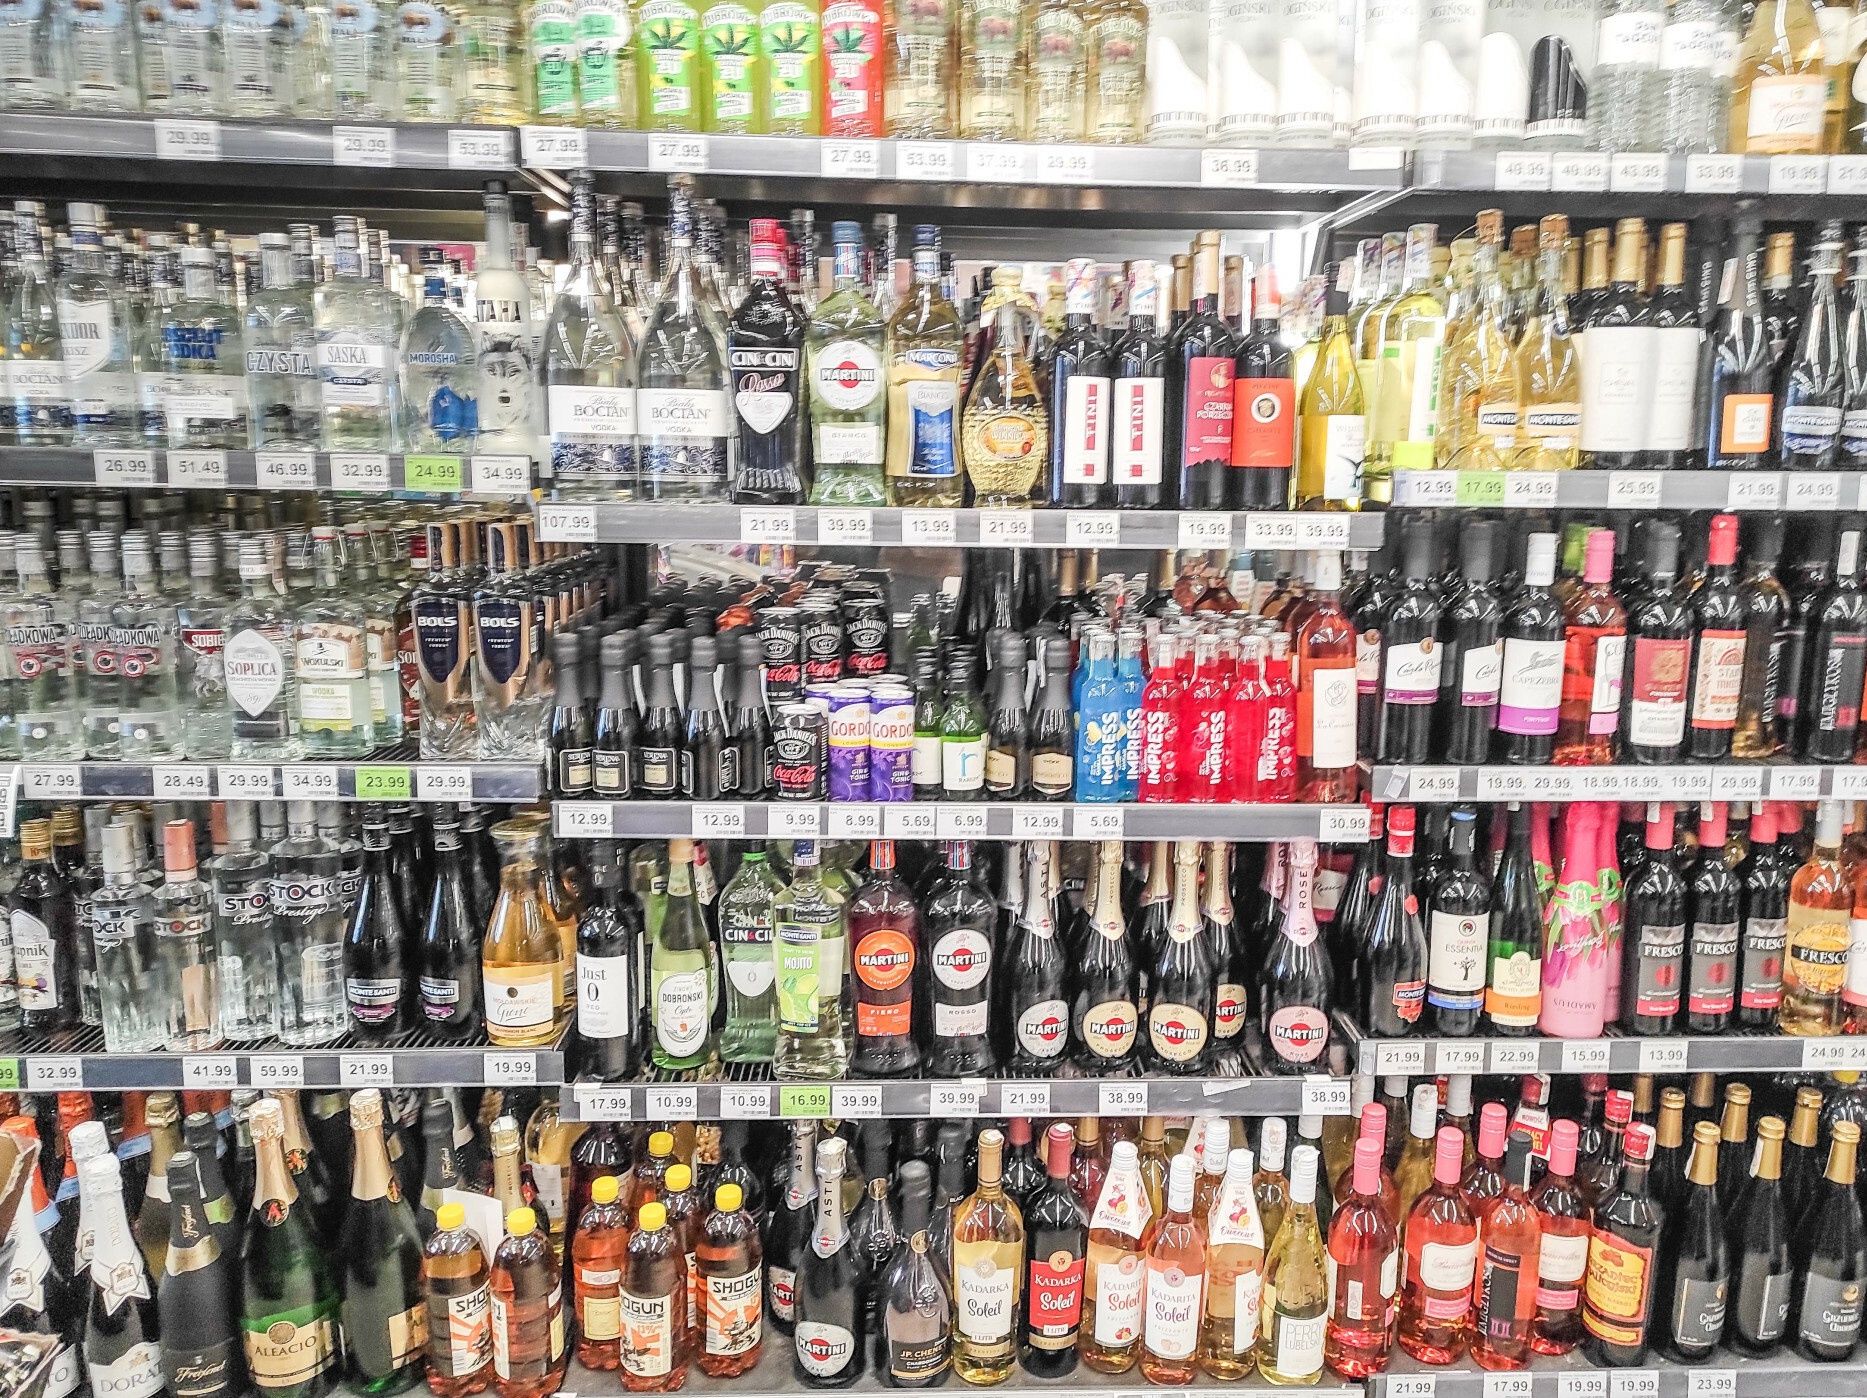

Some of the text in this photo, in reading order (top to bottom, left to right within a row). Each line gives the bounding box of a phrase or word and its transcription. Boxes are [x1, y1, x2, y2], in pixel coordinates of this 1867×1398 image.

[536, 139, 578, 153] 27.99
[659, 144, 700, 157] 27.99
[831, 150, 871, 163] 27.99
[327, 346, 368, 364] SASKA
[246, 350, 314, 375] CZYSTA
[820, 368, 875, 381] MARTINI
[573, 404, 630, 418] BOCIAN
[650, 407, 711, 420] BOCIAN
[105, 461, 146, 473] 26.99
[179, 461, 221, 474] 51.49
[266, 464, 307, 476] 46.99
[342, 465, 382, 477] 32.99
[415, 465, 456, 478] 24.99
[482, 467, 522, 480] 34.99
[1415, 481, 1452, 494] 12.99
[1465, 481, 1502, 494] 17.99
[1514, 482, 1551, 495] 24.99
[1737, 483, 1774, 496] 21.99
[541, 516, 591, 528] 107.99
[751, 520, 789, 532] 21.99
[827, 519, 866, 531] 39.99
[912, 521, 949, 533] 13.99
[989, 522, 1026, 534] 21.99
[1076, 523, 1113, 535] 12.99
[1188, 524, 1227, 536] 19.99
[1256, 525, 1293, 537] 33.99
[1306, 526, 1344, 538] 39.99
[417, 615, 458, 627] BOLS
[480, 616, 521, 628] BOLS
[227, 660, 279, 676] SOPLICA
[1101, 711, 1118, 785] IMPRESS
[1126, 707, 1144, 780] IMPRESS
[1147, 710, 1164, 785] IMPRESS
[1209, 710, 1226, 786] IMPRESS
[773, 764, 818, 784] Coca-Cola
[34, 774, 75, 787] 27.99
[163, 775, 203, 787] 28.49
[229, 775, 268, 787] 29.99
[292, 775, 331, 787] 34.99
[366, 776, 404, 788] 23.99
[426, 776, 466, 788] 29.99
[1418, 778, 1454, 790] 24.99
[1487, 777, 1523, 789] 19.99
[1534, 777, 1571, 789] 29.99
[1583, 777, 1618, 789] 18.99
[1623, 777, 1658, 789] 18.99
[1671, 777, 1707, 789] 19.99
[1720, 777, 1756, 789] 29.99
[1779, 776, 1815, 788] 17.99
[569, 814, 607, 825] 12.99
[702, 814, 740, 826] 12.99
[786, 814, 815, 826] 9.99
[846, 815, 875, 827] 8.99
[902, 815, 931, 827] 5.69
[954, 815, 983, 827] 6.99
[1022, 816, 1058, 828] 12.99
[1090, 816, 1119, 827] 5.69
[1329, 817, 1365, 829] 30.99
[1040, 862, 1049, 899] ASTI
[268, 879, 334, 900] STOCK
[1445, 943, 1484, 955] ESSENTIA
[1644, 942, 1684, 959] FRESCO
[1695, 940, 1737, 956] FRESCO
[860, 952, 910, 967] MARTINI
[938, 952, 987, 967] MARTINI
[1800, 949, 1849, 965] FRESCO
[783, 957, 813, 970] MOJITO
[581, 965, 608, 982] Just
[948, 1008, 978, 1017] ROSSO
[1026, 1018, 1067, 1035] MARTINI
[1091, 1019, 1135, 1035] MARTINI
[1153, 1022, 1200, 1040] MARTINI
[1275, 1025, 1324, 1040] MARTINI
[1385, 1052, 1420, 1063] 21.99
[1445, 1052, 1479, 1063] 17.99
[1499, 1051, 1534, 1062] 22.99
[1571, 1050, 1605, 1061] 15.99
[1649, 1050, 1683, 1061] 13.99
[1810, 1047, 1844, 1058] 24.99
[37, 1067, 77, 1079] 32.99
[193, 1065, 232, 1077] 41.99
[260, 1065, 299, 1077] 59.99
[349, 1064, 388, 1075] 21.99
[494, 1061, 531, 1073] 19.99
[656, 1096, 692, 1108] 10.99
[729, 1096, 766, 1107] 10.99
[790, 1095, 825, 1106] 16.99
[841, 1095, 878, 1107] 39.99
[939, 1093, 975, 1105] 39.99
[1010, 1093, 1045, 1105] 21.99
[1108, 1092, 1143, 1104] 38.99
[1311, 1092, 1346, 1103] 38.99
[590, 1098, 626, 1110] 17.99
[824, 1176, 833, 1219] ASTI
[1034, 1270, 1084, 1288] KADARKA
[961, 1278, 1011, 1295] KADARKA
[1039, 1289, 1077, 1312] Soleil
[967, 1297, 1003, 1318] Soleil
[1154, 1301, 1192, 1323] Soleil
[253, 1334, 318, 1359] ALEACIO
[798, 1335, 847, 1357] MARTINI
[1395, 1382, 1431, 1394] 21.99
[1493, 1381, 1528, 1392] 17.99
[1568, 1381, 1602, 1392] 19.99
[1620, 1380, 1654, 1391] 19.99
[1697, 1379, 1731, 1390] 23.99
